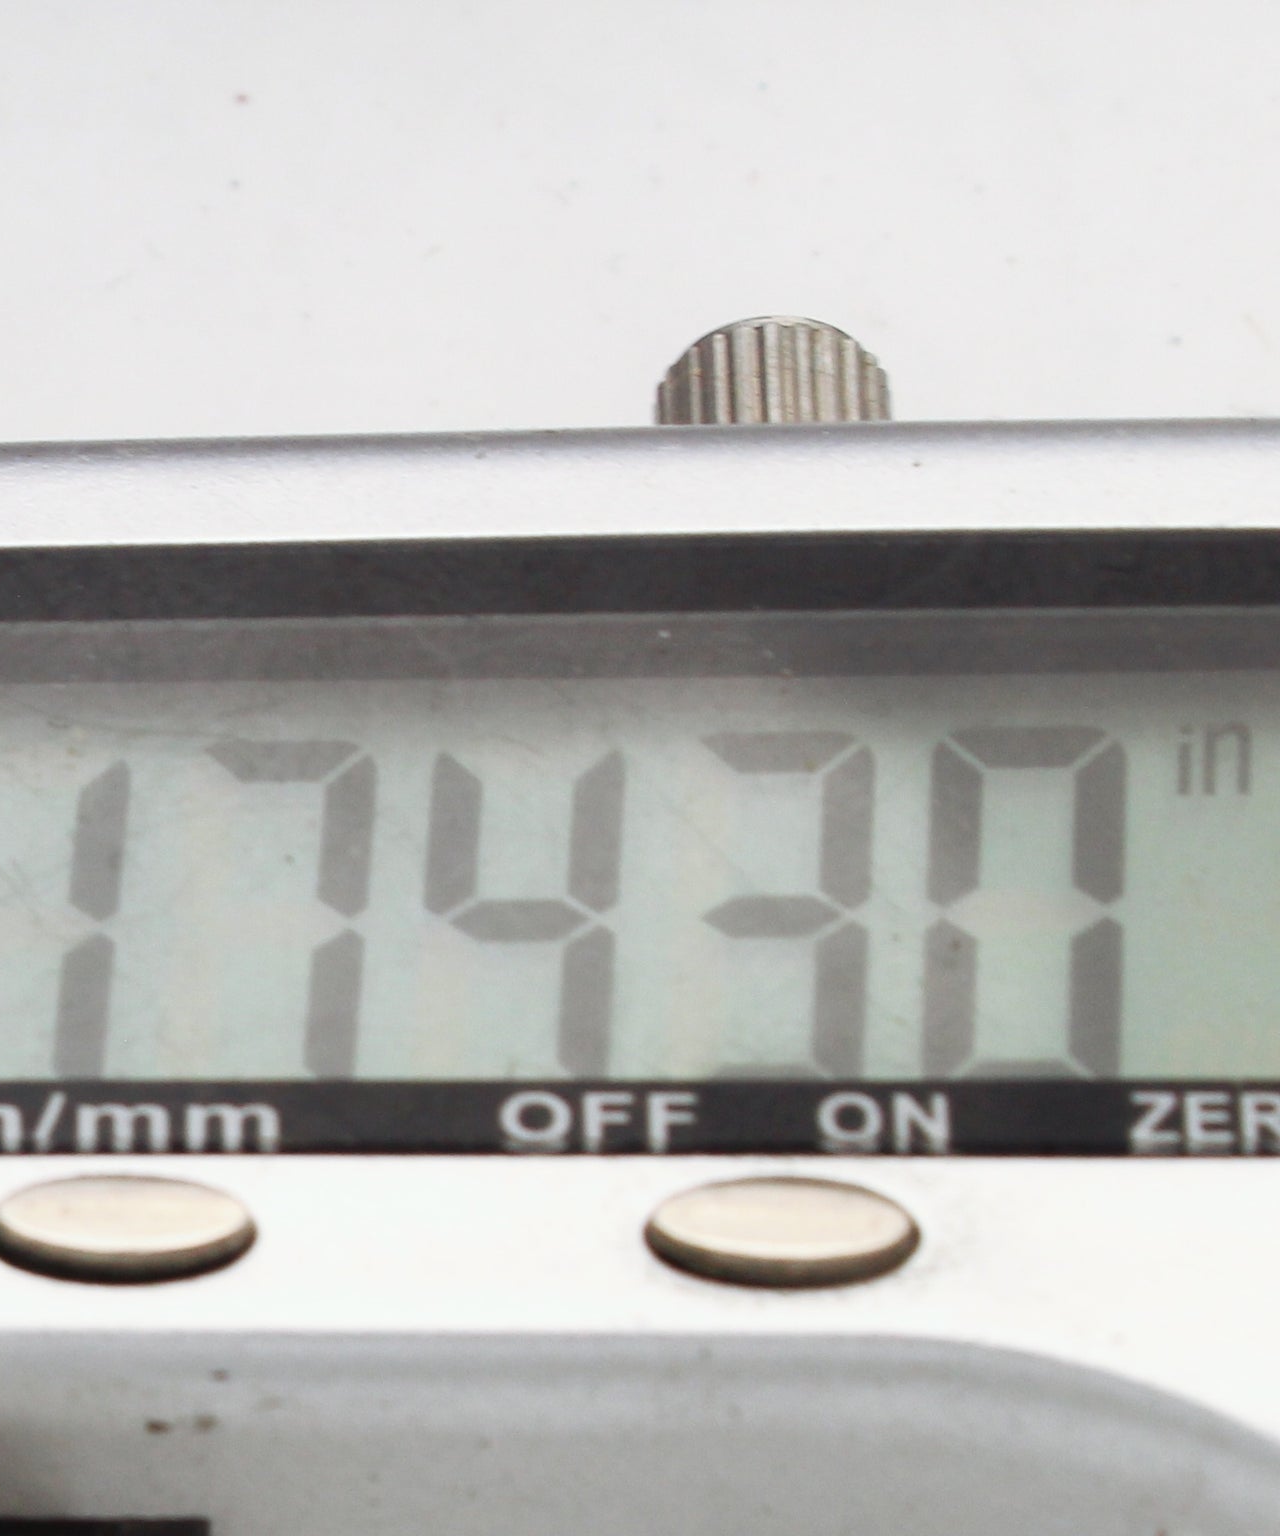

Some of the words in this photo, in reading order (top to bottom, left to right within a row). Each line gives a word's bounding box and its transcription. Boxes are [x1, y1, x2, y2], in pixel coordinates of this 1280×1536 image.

[1177, 720, 1252, 798] in
[499, 1089, 697, 1152] OFF
[817, 1090, 952, 1153] ON
